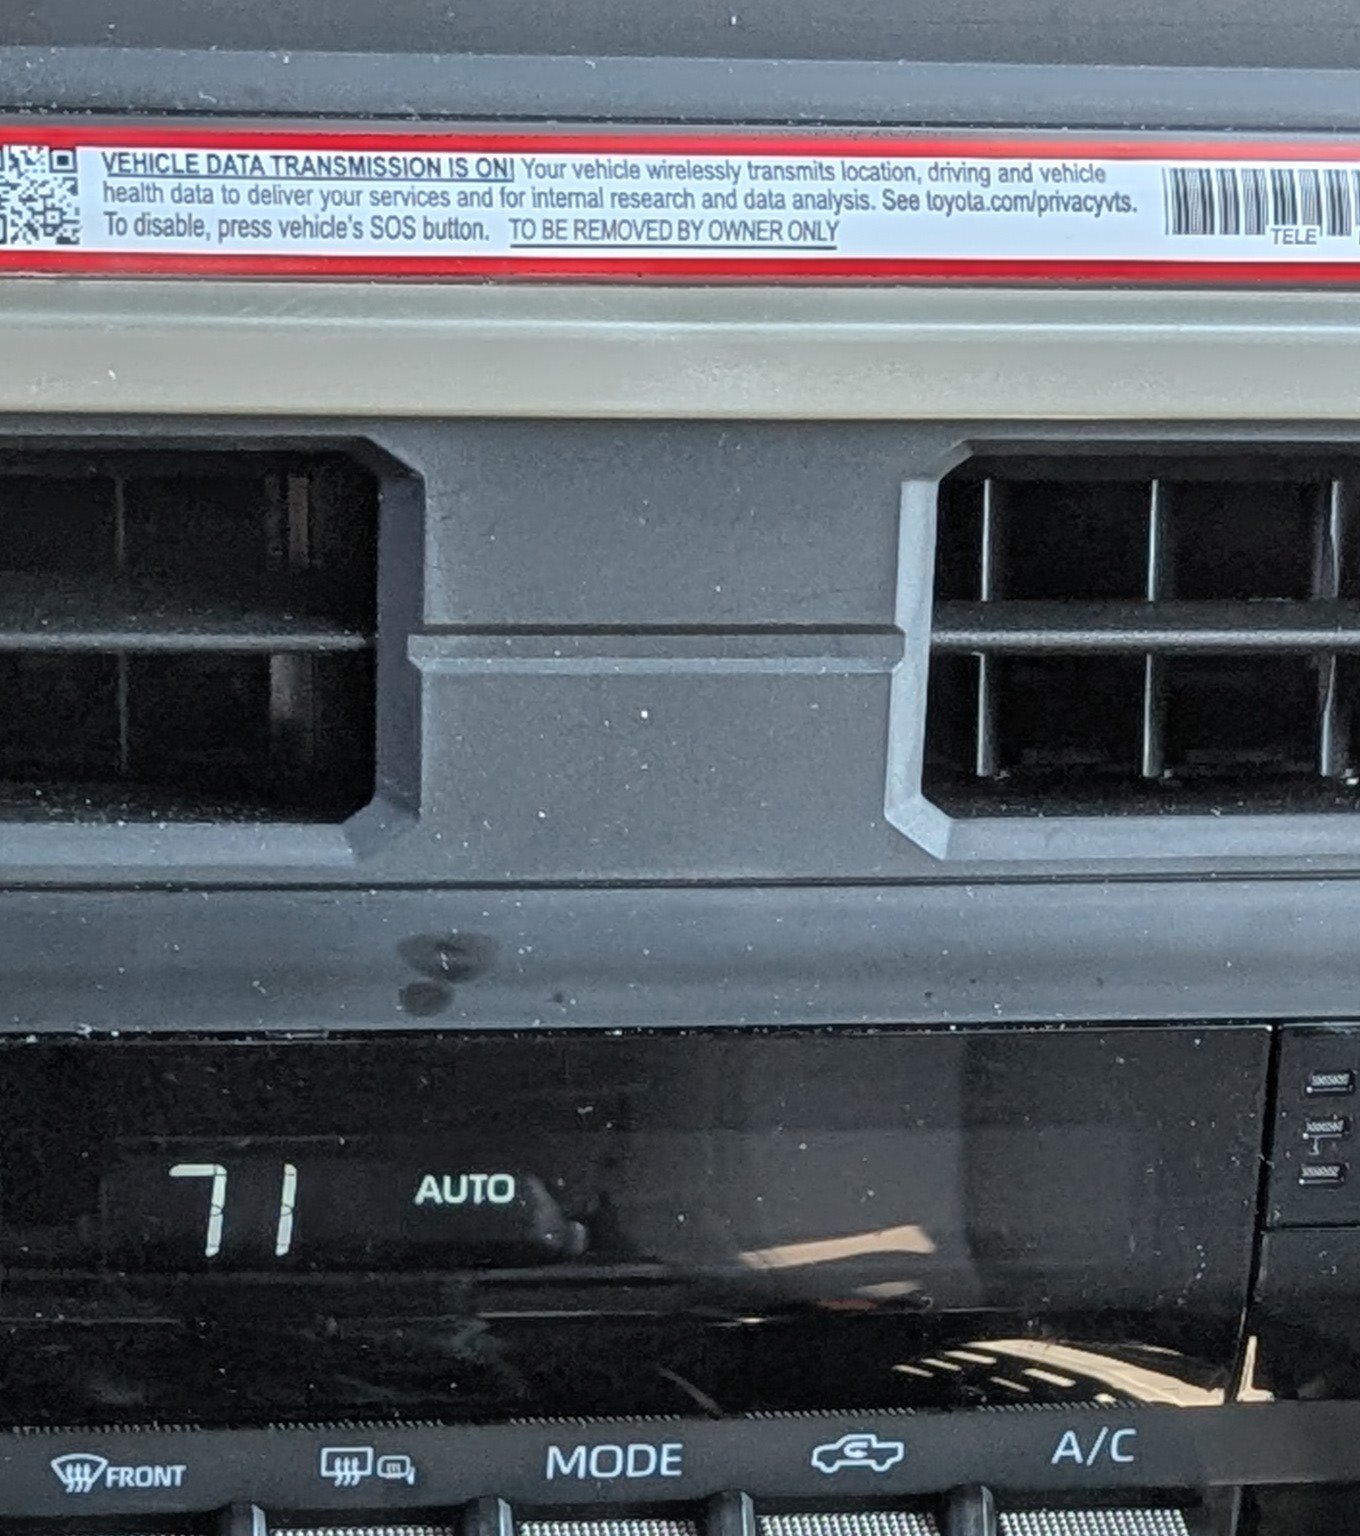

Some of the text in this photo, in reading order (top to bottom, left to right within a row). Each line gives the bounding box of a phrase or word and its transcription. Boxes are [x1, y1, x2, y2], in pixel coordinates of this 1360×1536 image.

[101, 152, 200, 174] VEHICLE
[207, 154, 266, 175] DATA
[270, 155, 441, 178] TRANSMISSION
[449, 157, 469, 177] IS
[521, 158, 567, 179] Your
[572, 159, 640, 180] vehicle
[646, 159, 741, 185] wirelessly
[747, 160, 835, 181] transmits
[842, 161, 922, 184] location,
[928, 162, 990, 188] driving
[998, 162, 1033, 183] and
[1039, 163, 1106, 183] vehicle
[103, 181, 164, 203] health
[171, 182, 214, 204] data
[221, 184, 240, 205] to
[248, 184, 313, 206] deliver
[320, 188, 363, 211] your
[369, 185, 451, 207] services
[457, 186, 493, 207] and
[499, 186, 527, 207] for
[532, 186, 604, 208] internal
[610, 187, 695, 209] research
[702, 188, 737, 209] and
[744, 188, 786, 210] data
[793, 188, 876, 215] analysis.
[882, 189, 920, 211] See
[103, 211, 840, 243] To disable, press vehicle's SOS button. TO BE REMOVED BY OWNER ONLY
[1271, 228, 1317, 245] TELE
[169, 1164, 515, 1257] 71 AUTO
[546, 1444, 683, 1480] MODE
[1051, 1427, 1138, 1465] A/C
[105, 1464, 187, 1487] FRONT
